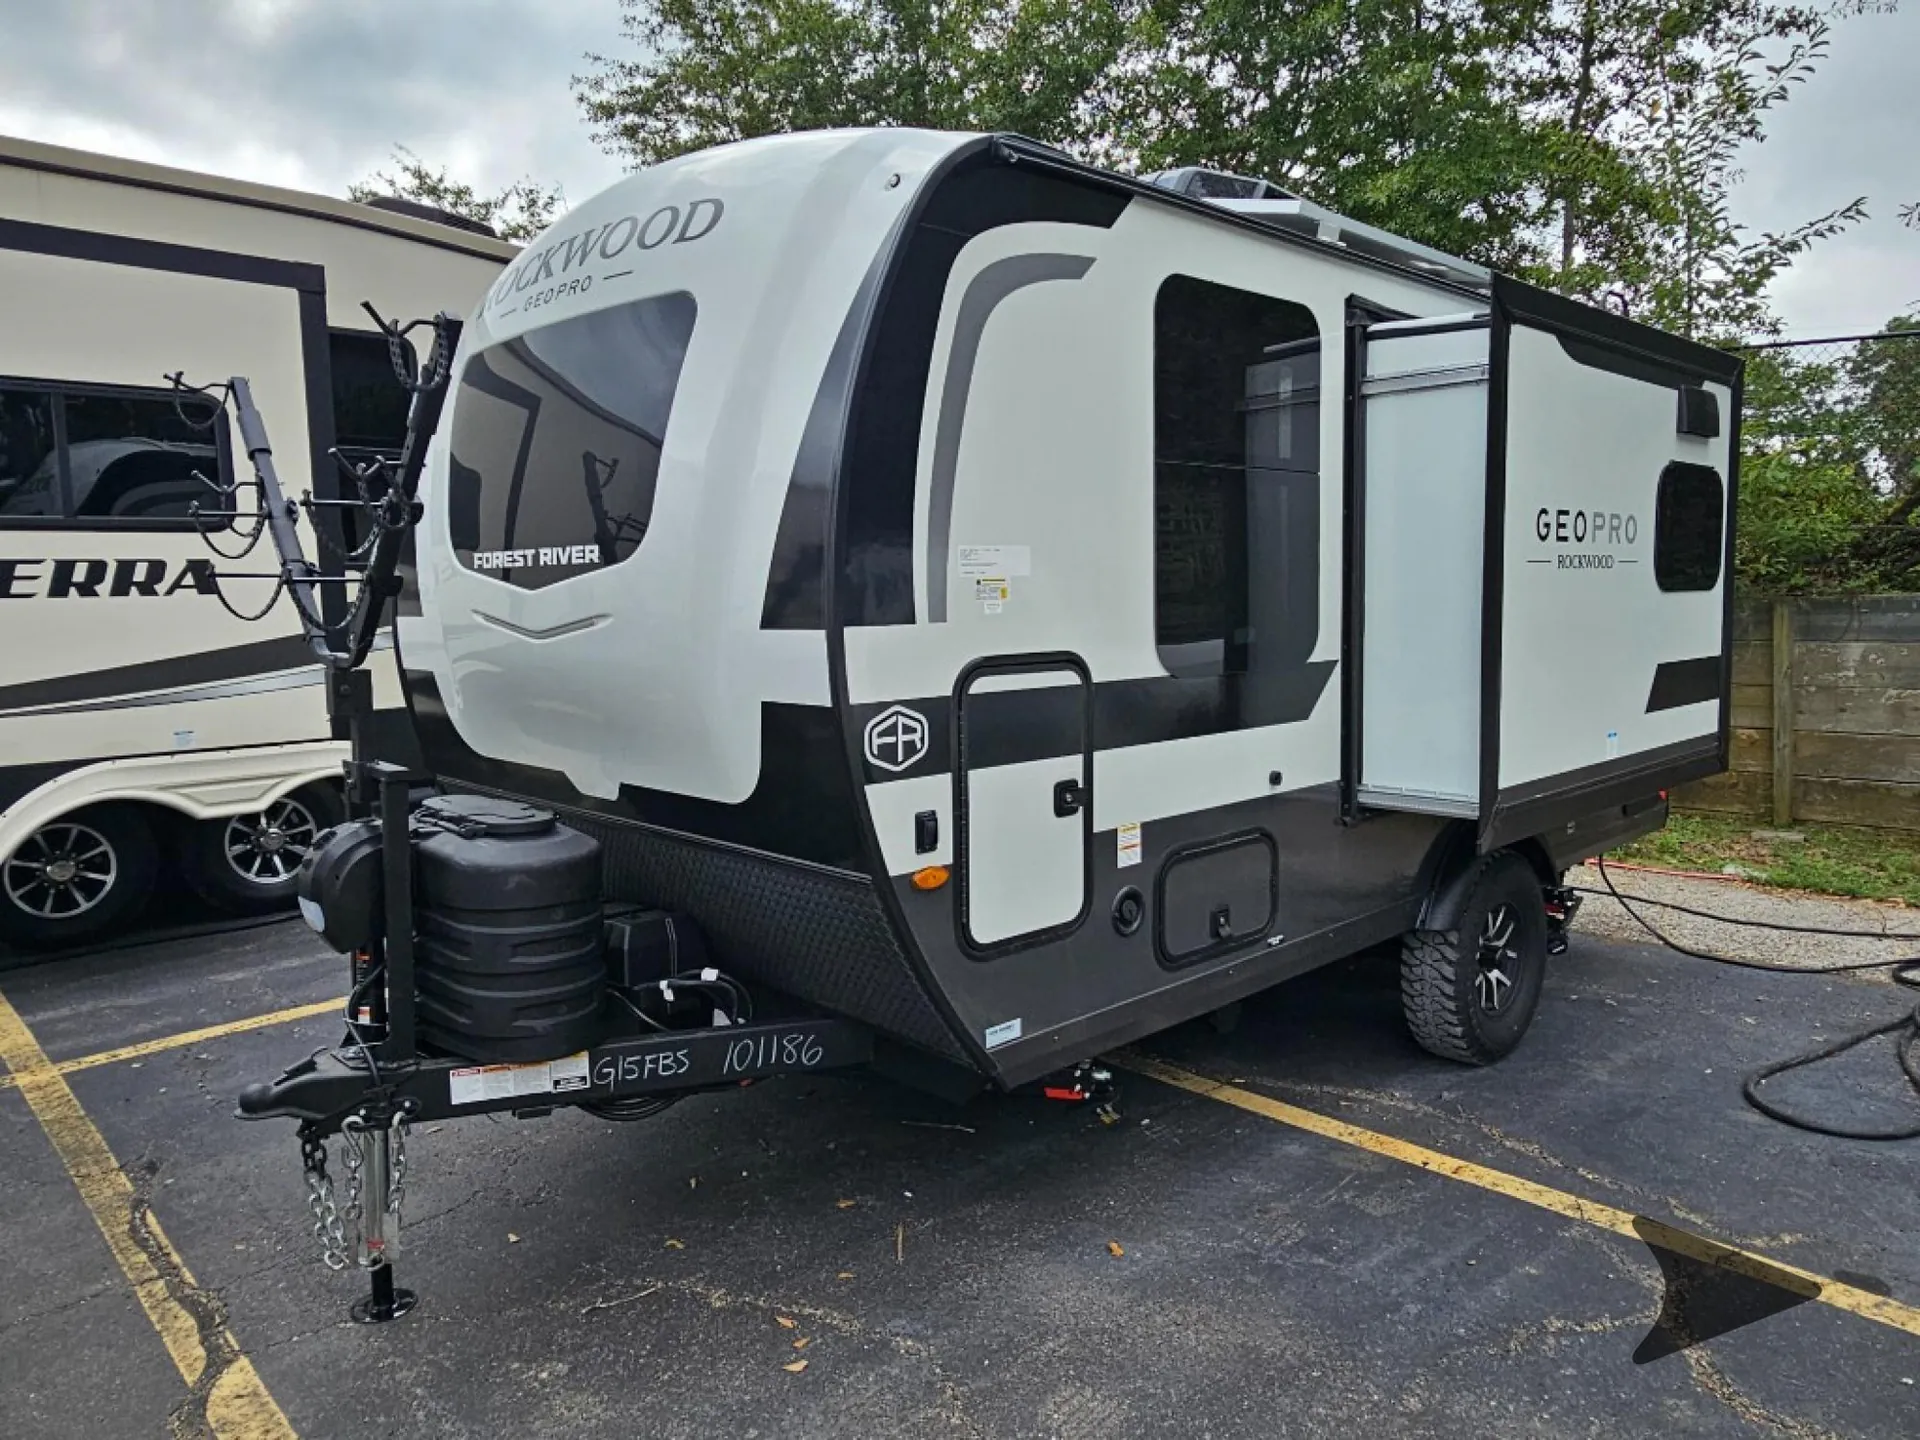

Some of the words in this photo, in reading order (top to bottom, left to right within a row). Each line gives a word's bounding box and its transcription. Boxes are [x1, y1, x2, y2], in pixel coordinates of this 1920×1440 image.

[524, 274, 593, 312] GEOPRO
[1536, 507, 1638, 544] GEOPRO
[473, 549, 536, 569] FOREST
[539, 544, 600, 566] RIVER
[1557, 554, 1614, 569] ROCKWOOD
[593, 1048, 690, 1093] G15FBS
[723, 1034, 823, 1075] 101186
